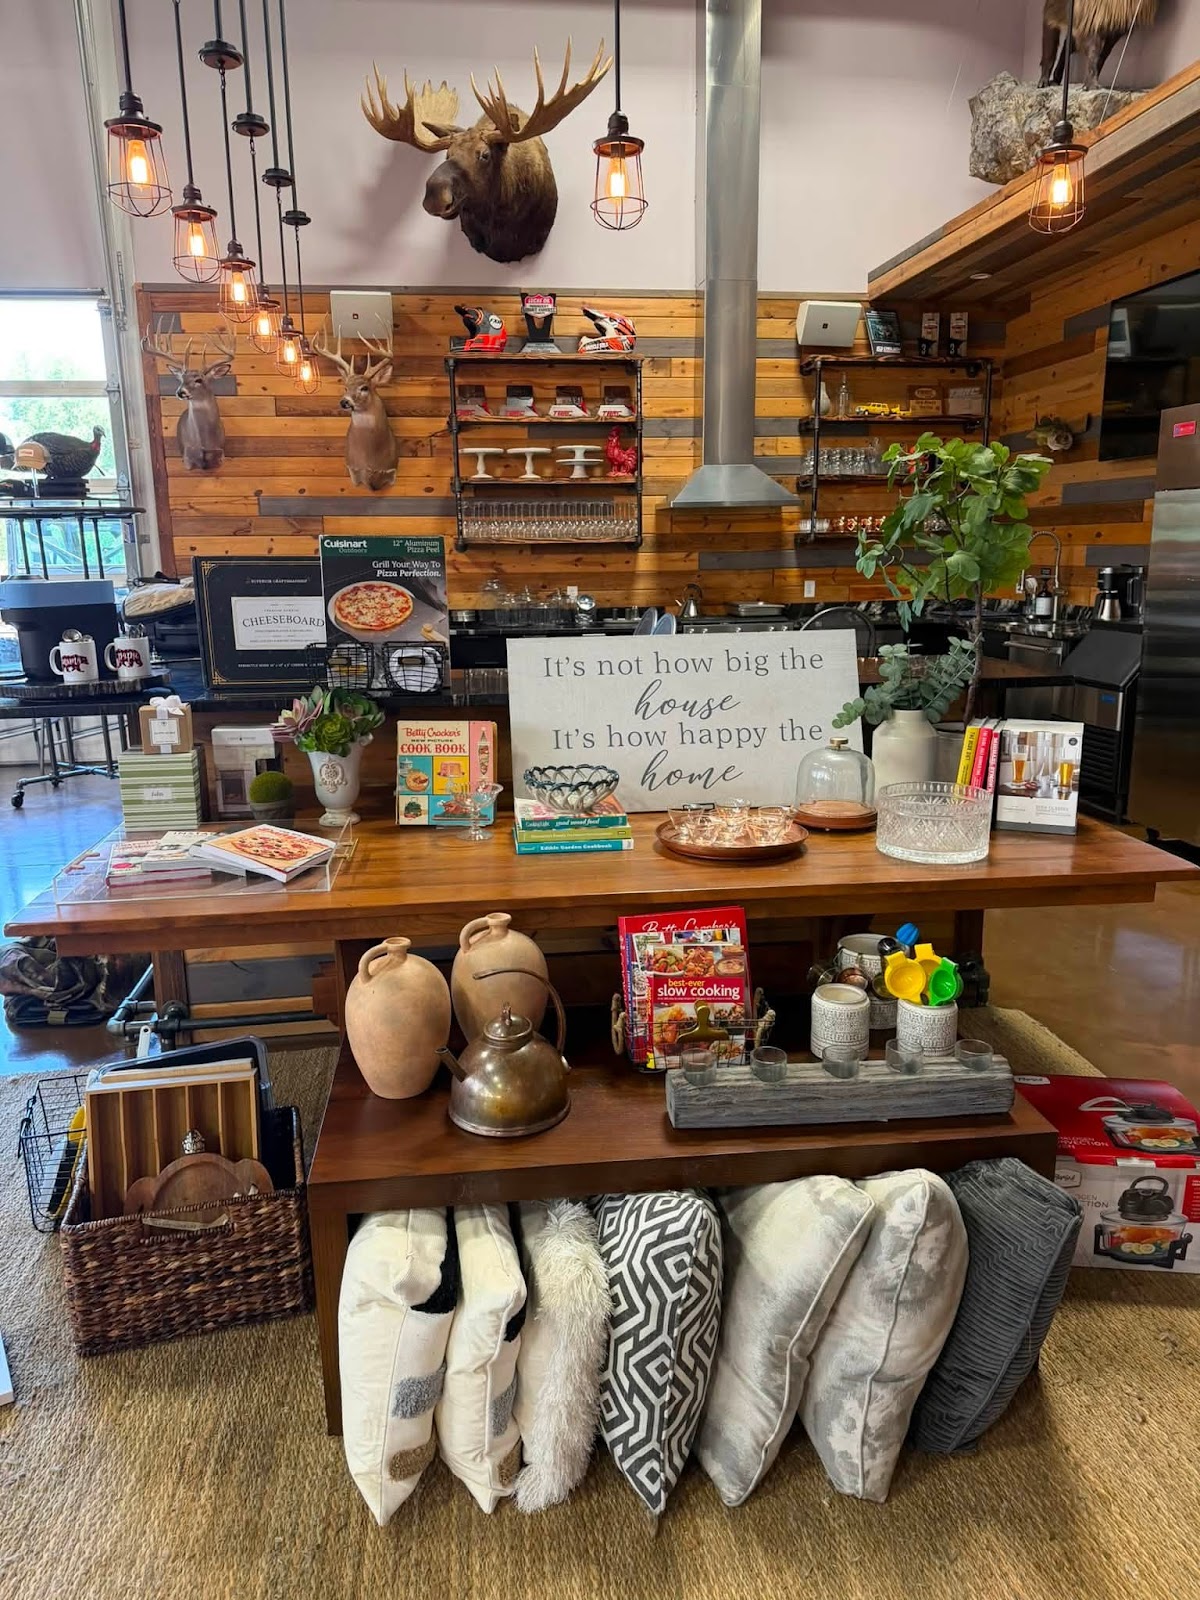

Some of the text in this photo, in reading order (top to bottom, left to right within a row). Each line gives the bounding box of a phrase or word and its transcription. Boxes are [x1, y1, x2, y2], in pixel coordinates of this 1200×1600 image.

[323, 539, 368, 548] Cuisinart
[372, 560, 441, 570] Grill Your Way To
[376, 569, 442, 577] Pizza Perfection.
[242, 615, 325, 628] CHEESEBOARD
[543, 647, 824, 678] It's not how big the
[634, 679, 741, 720] house
[402, 727, 461, 738] Betty Crocker's
[552, 719, 823, 750] It's how happy the
[400, 743, 466, 754] COOK BOOK
[640, 750, 744, 791] home
[555, 818, 569, 826] good
[586, 817, 600, 825] food
[668, 979, 706, 987] best-ever
[657, 984, 740, 999] slow cooking
